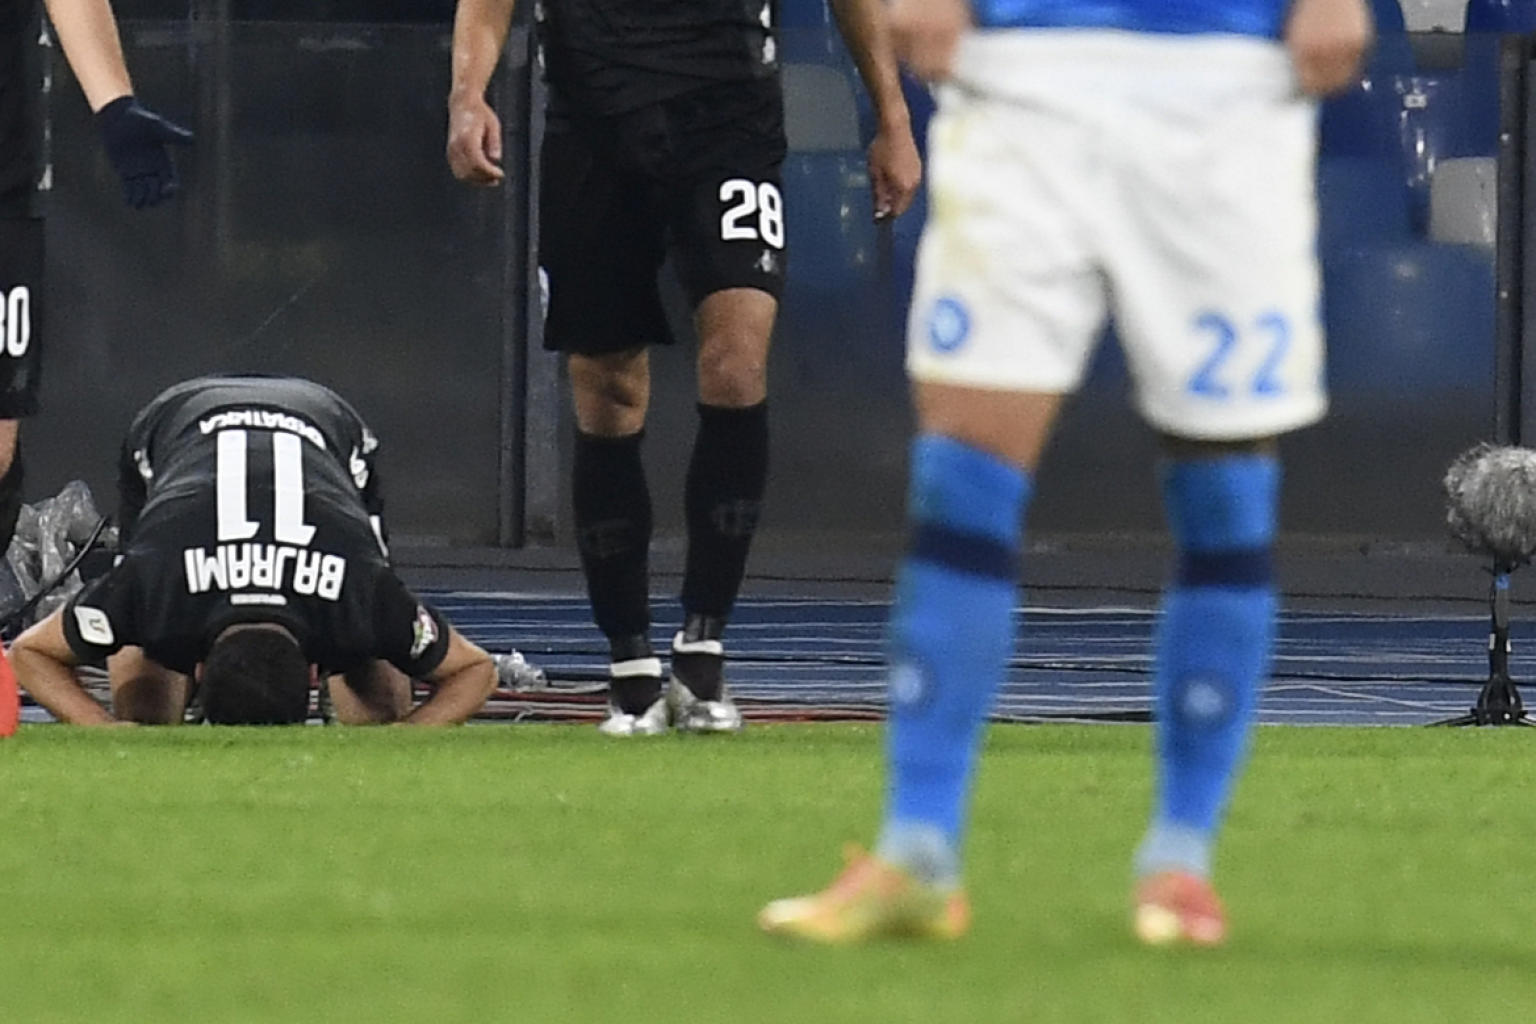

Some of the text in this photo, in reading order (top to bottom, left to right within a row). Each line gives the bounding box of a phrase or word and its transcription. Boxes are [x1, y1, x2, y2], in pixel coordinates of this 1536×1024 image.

[720, 179, 783, 249] 28
[1188, 310, 1291, 398] 22
[217, 430, 317, 546] 11
[184, 543, 345, 602] BAJRAMI
